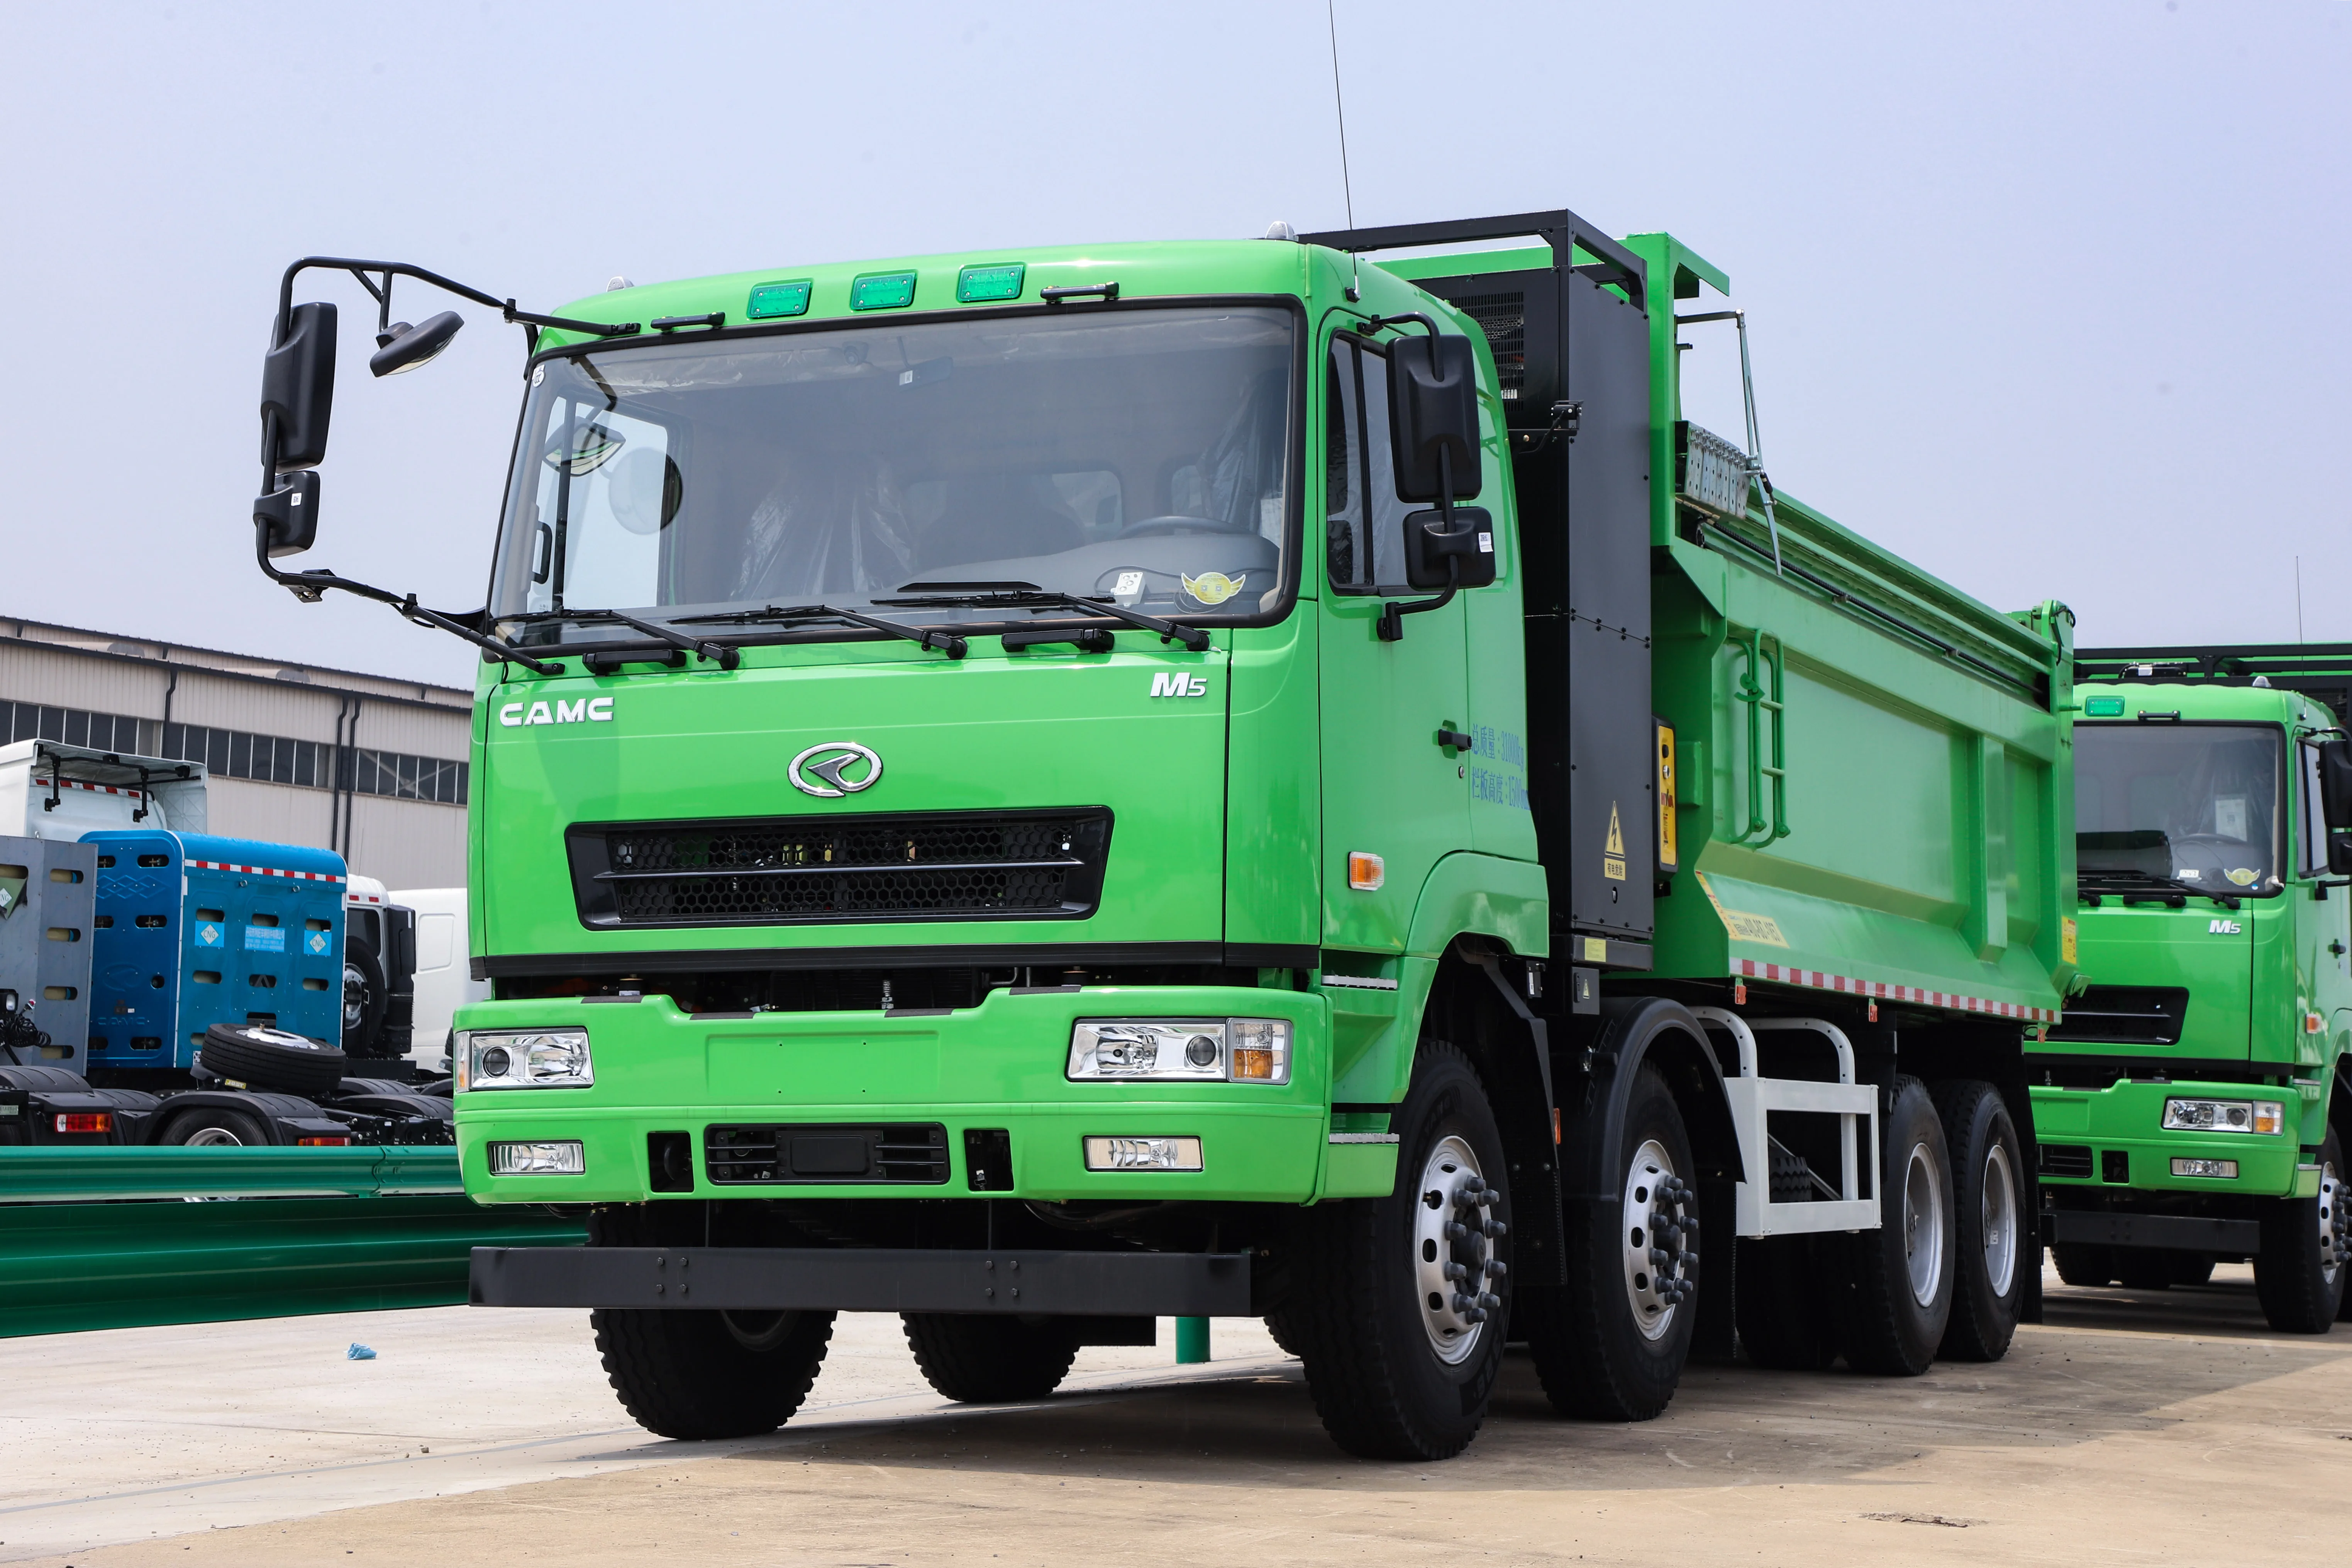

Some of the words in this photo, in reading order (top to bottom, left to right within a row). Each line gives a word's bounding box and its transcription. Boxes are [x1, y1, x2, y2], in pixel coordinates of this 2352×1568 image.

[1150, 672, 1207, 697] M5
[499, 697, 614, 726] CAMC
[2209, 920, 2241, 934] M5
[203, 930, 215, 939] CNG
[312, 939, 323, 947] CNG
